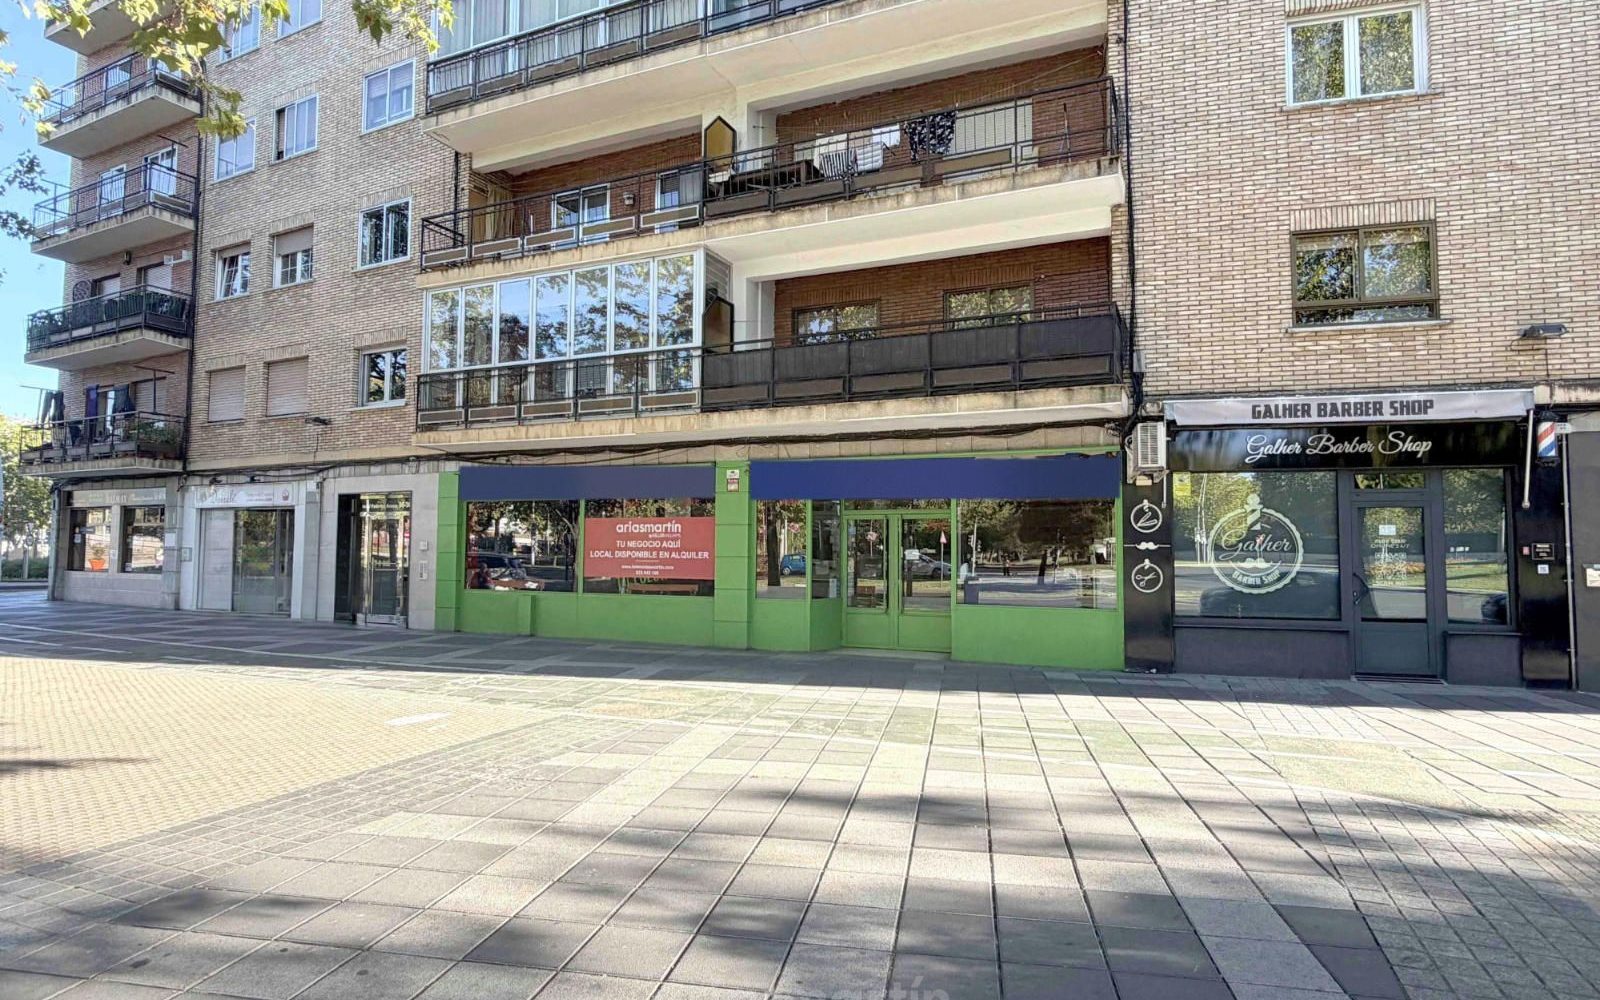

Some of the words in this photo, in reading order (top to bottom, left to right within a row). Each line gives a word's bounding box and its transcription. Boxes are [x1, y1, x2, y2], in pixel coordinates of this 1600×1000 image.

[1251, 403, 1312, 420] GALHER
[1317, 401, 1384, 418] BARBER
[1389, 399, 1434, 416] SHOP
[1245, 434, 1302, 464] Galher
[1306, 433, 1375, 455] Barber
[1378, 431, 1432, 458] Shop
[616, 540, 625, 548] TU
[627, 540, 660, 548] NEGOCIO
[662, 539, 681, 548] AQUÍ
[590, 550, 613, 558] LOCAL
[615, 550, 657, 559] DISPONIBLE
[659, 551, 669, 559] EN
[670, 551, 709, 559] ALQUILER
